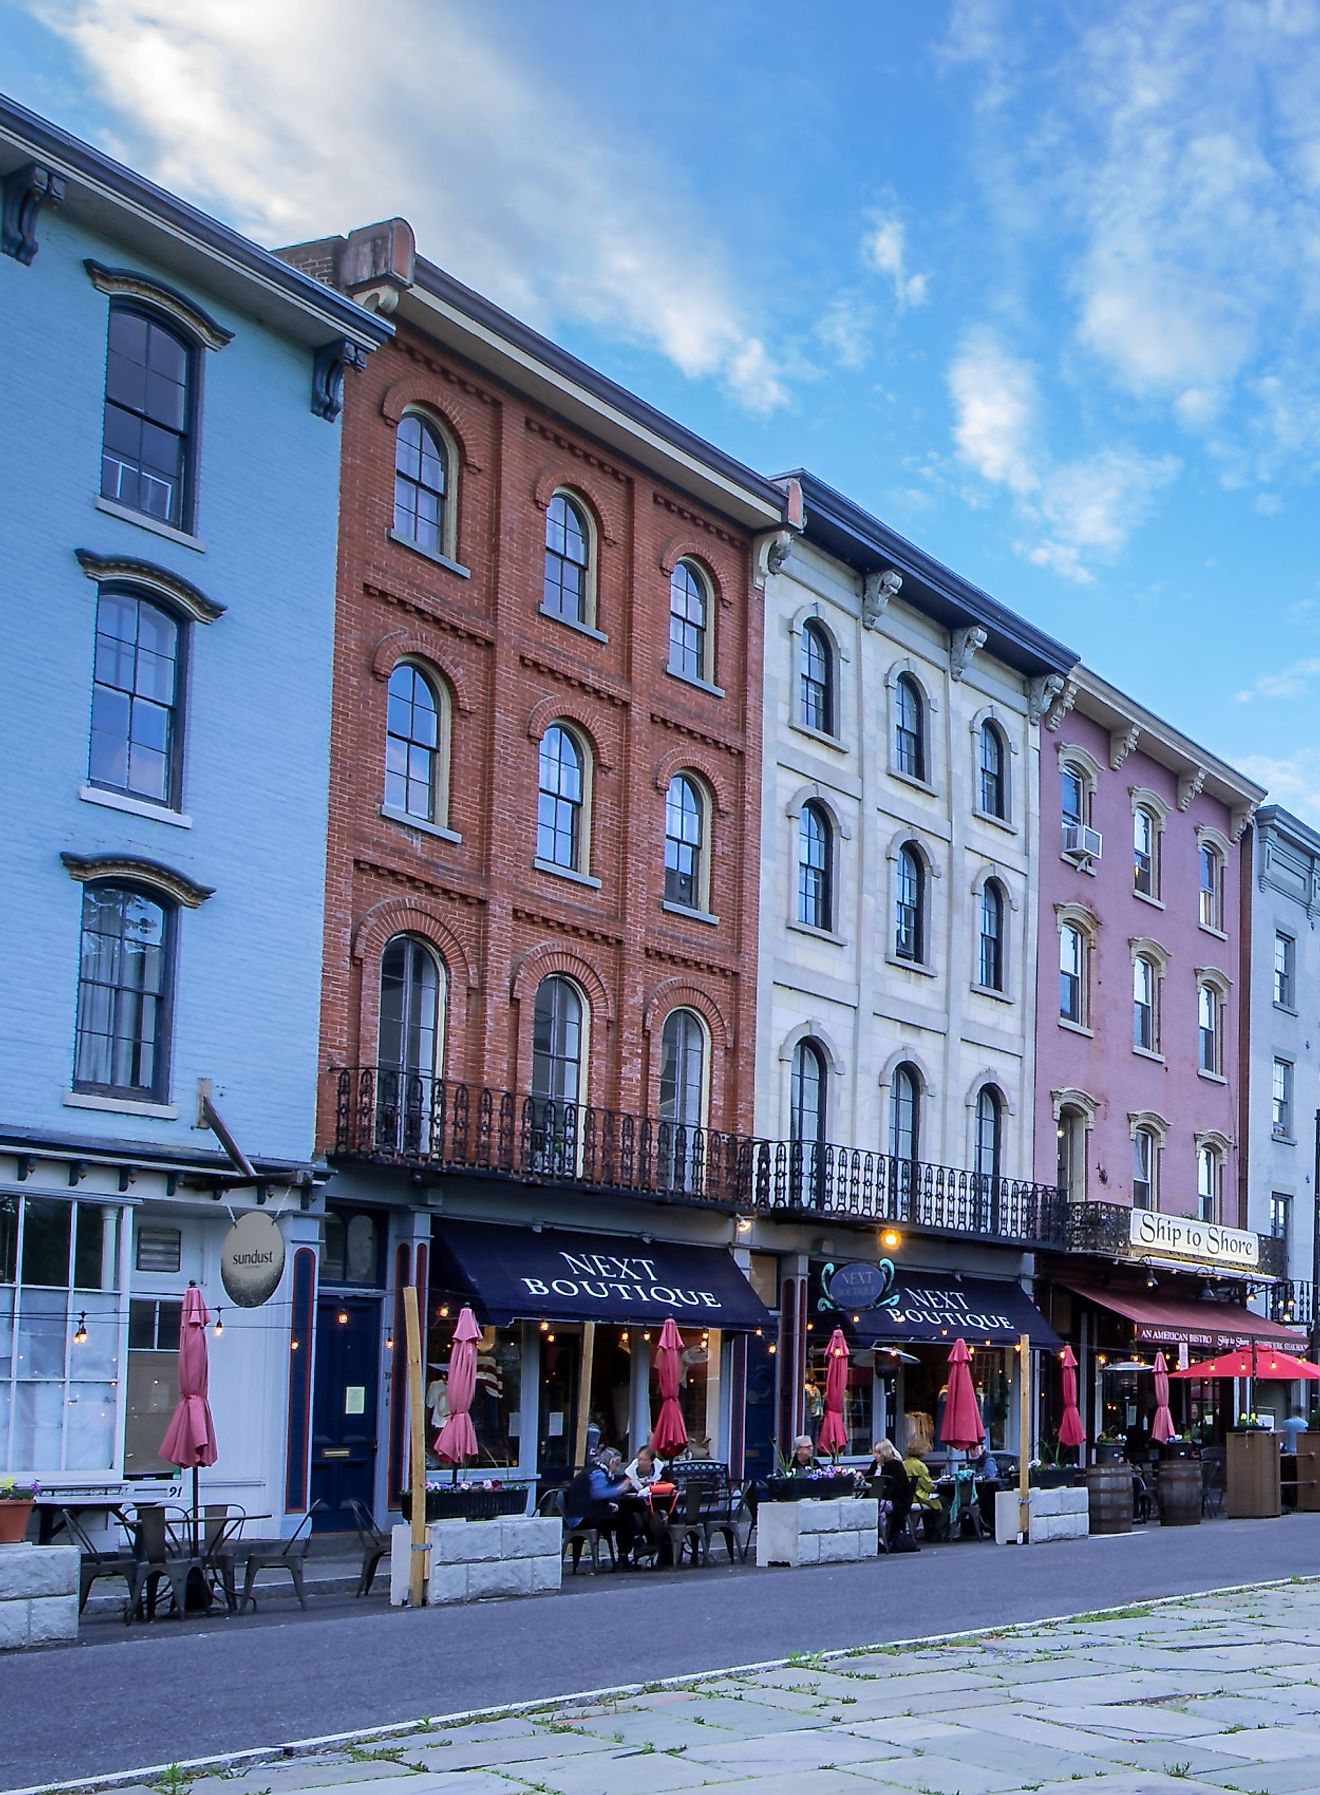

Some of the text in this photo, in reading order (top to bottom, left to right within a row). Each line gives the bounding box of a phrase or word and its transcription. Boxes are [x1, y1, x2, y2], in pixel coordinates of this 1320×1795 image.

[1140, 1213, 1253, 1256] Ship to Shore
[233, 1249, 273, 1265] sundust
[559, 1251, 658, 1281] NEXT
[841, 1271, 874, 1285] NEXT
[520, 1278, 722, 1308] BOUTIQUE
[905, 1287, 969, 1310] NEXT
[886, 1308, 1015, 1331] BOUTIQUE
[1141, 1329, 1152, 1338] AN
[1152, 1330, 1188, 1342] AMERICAN
[1189, 1333, 1212, 1344] BISTRO
[169, 1486, 182, 1497] 91
